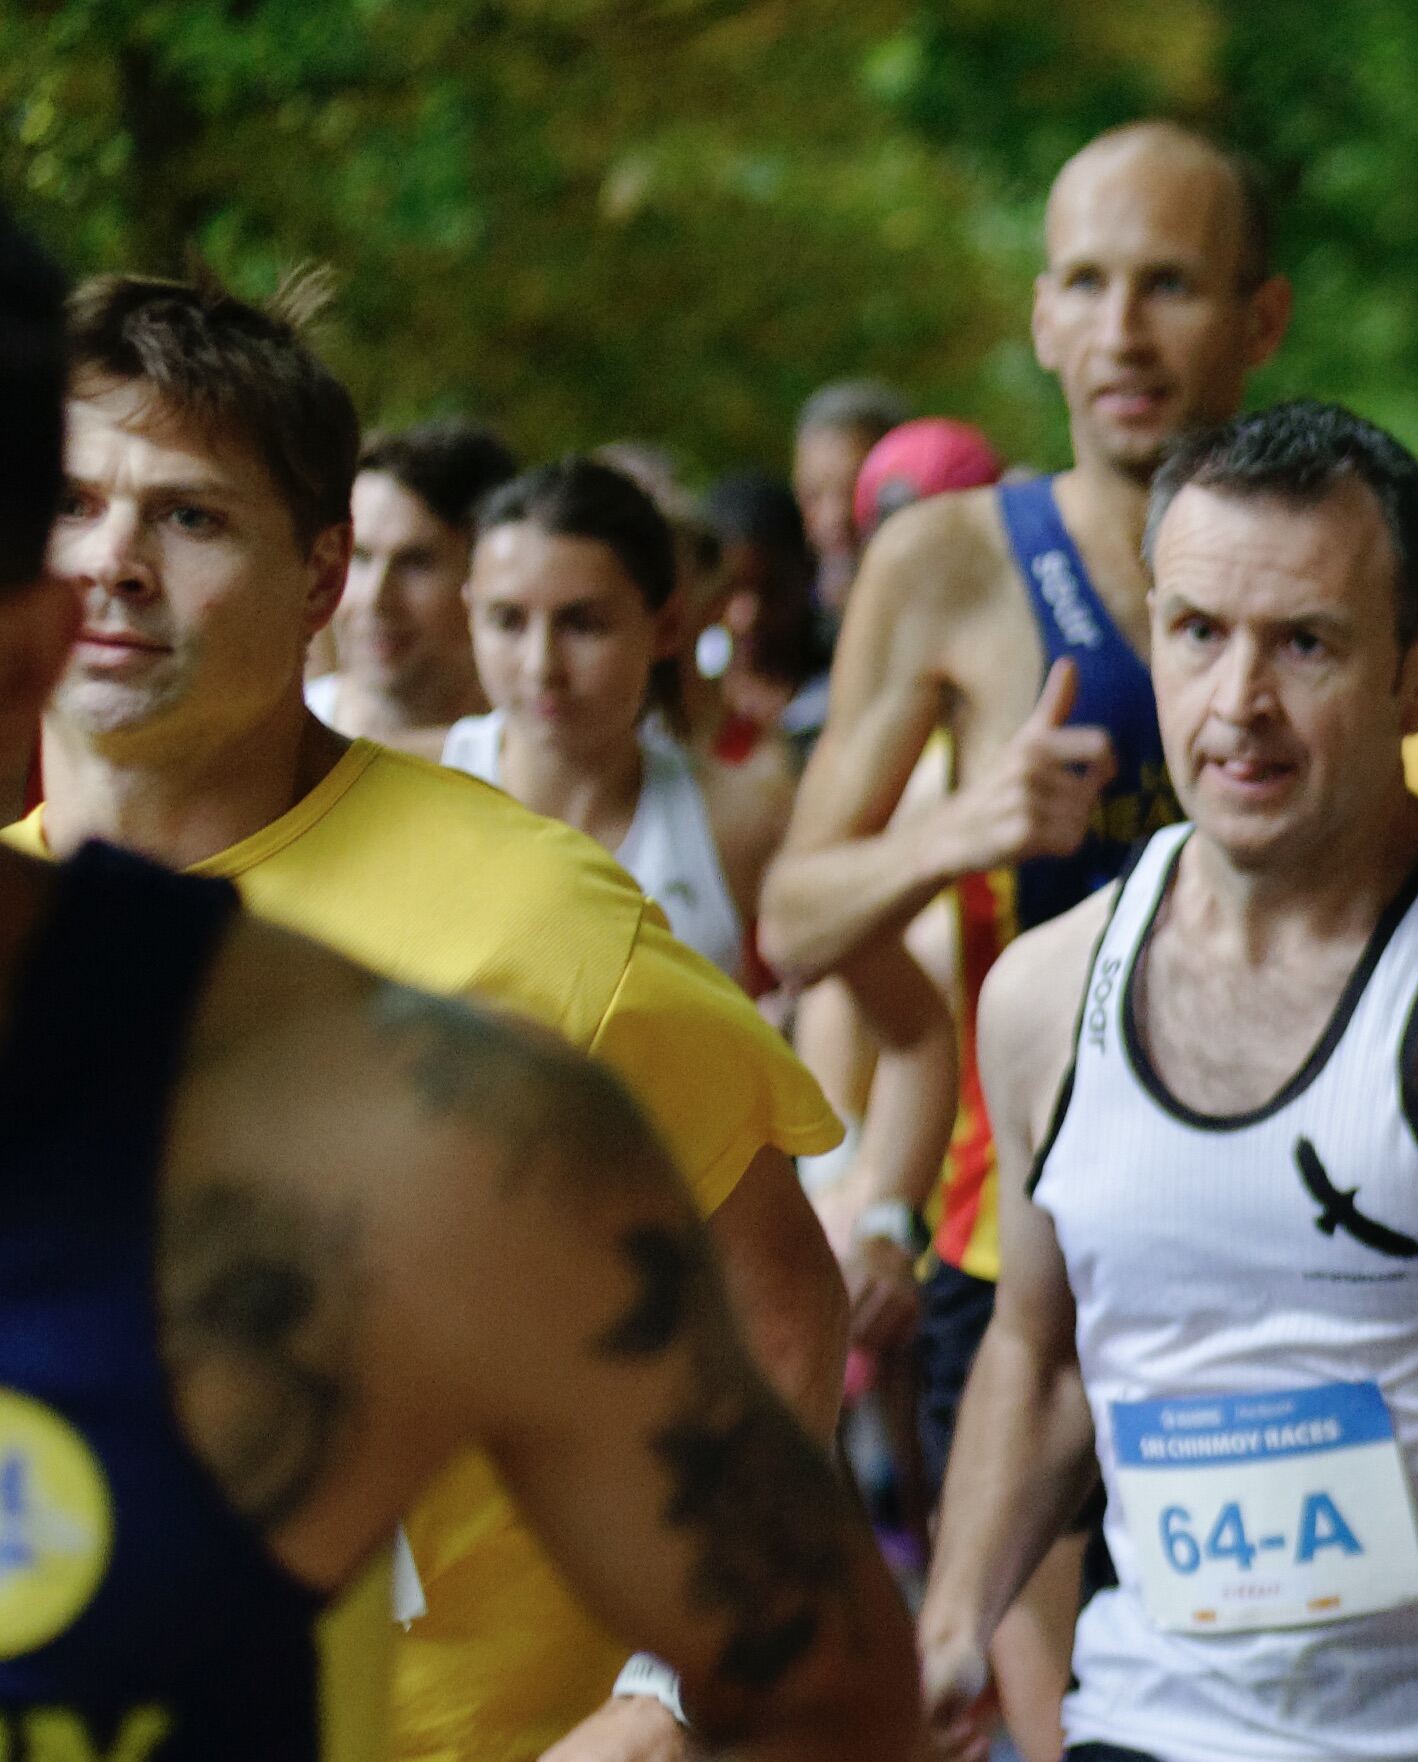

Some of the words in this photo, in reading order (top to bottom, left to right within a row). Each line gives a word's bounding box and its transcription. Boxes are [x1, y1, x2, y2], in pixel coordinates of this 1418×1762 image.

[1167, 1428, 1258, 1458] CHINMOY
[1264, 1418, 1341, 1448] RACES
[1158, 1490, 1364, 1576] 64-A
